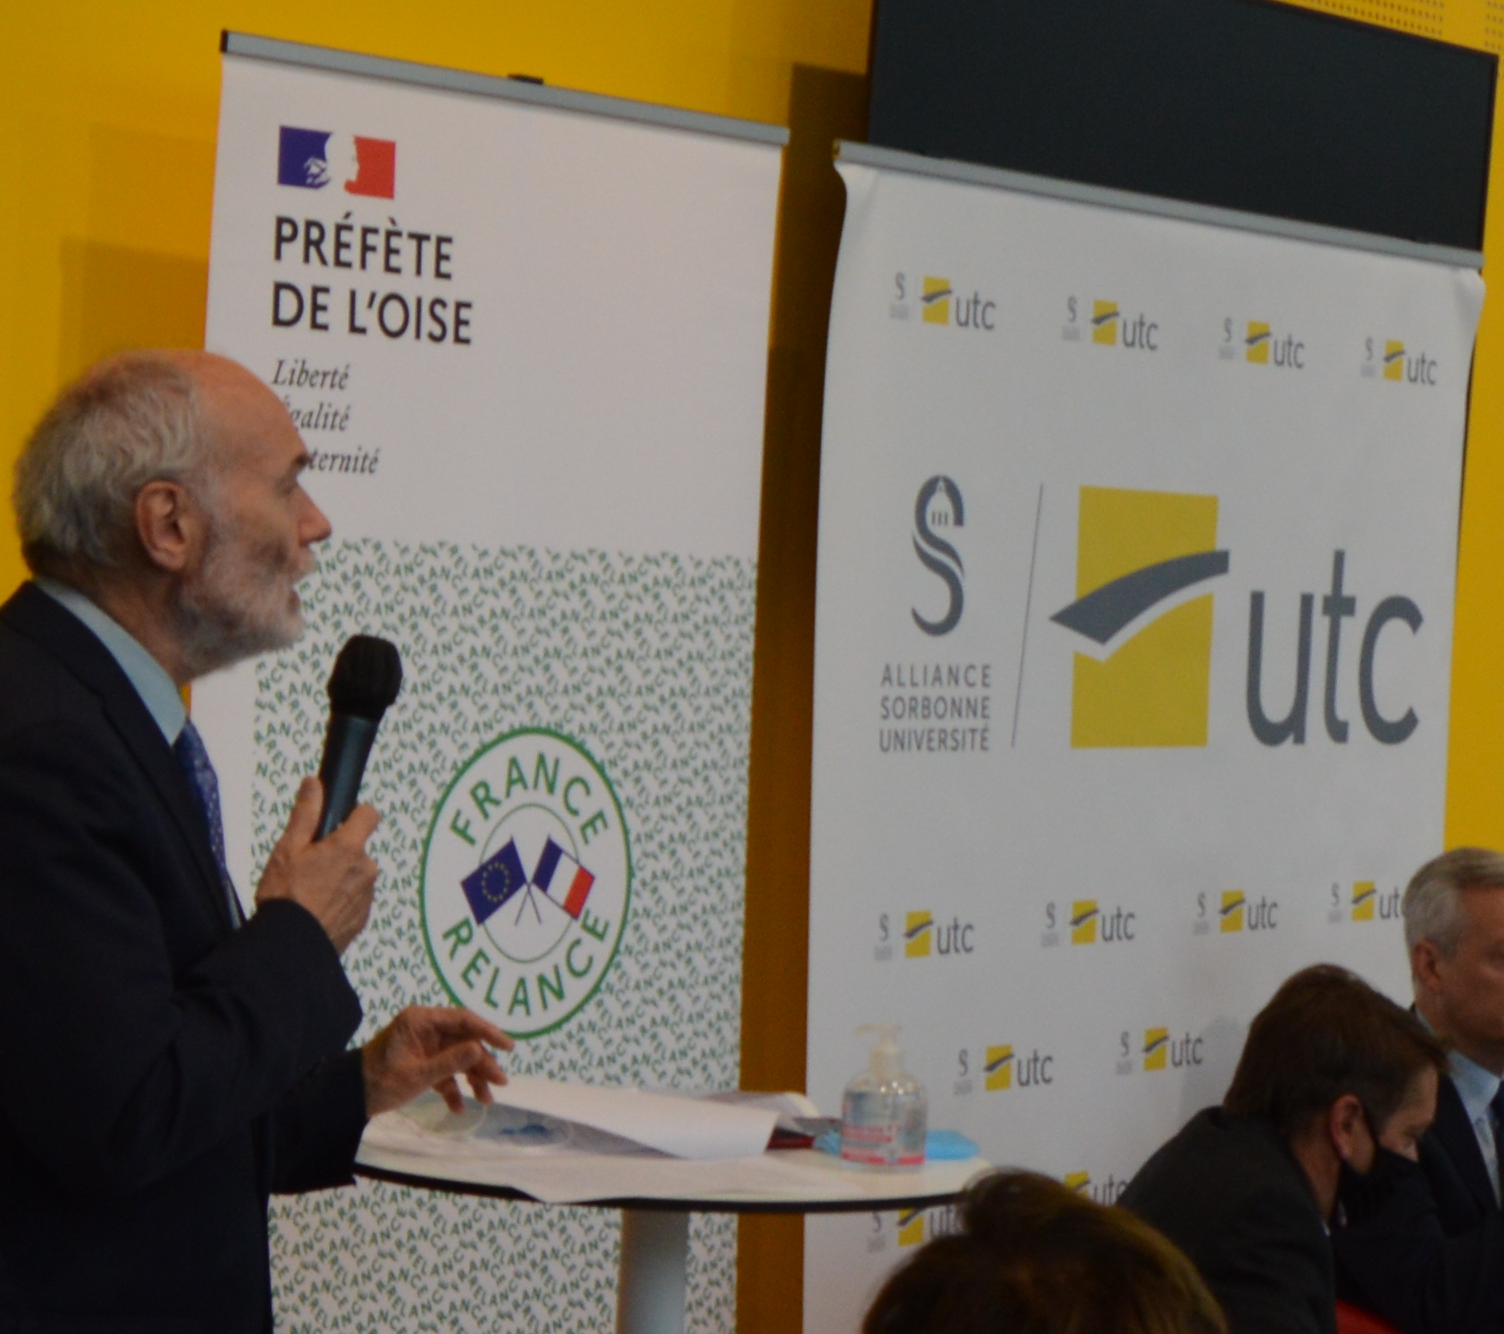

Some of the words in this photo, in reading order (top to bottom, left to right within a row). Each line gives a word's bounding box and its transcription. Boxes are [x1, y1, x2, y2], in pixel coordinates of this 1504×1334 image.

[273, 210, 454, 280] PRÉFÈTE
[272, 281, 330, 332] DE
[349, 289, 473, 345] L'OISE
[955, 291, 996, 331] utc
[1122, 313, 1159, 351] utc
[1273, 334, 1305, 369] utc
[1407, 352, 1437, 386] utc
[272, 359, 349, 391] Liberté
[1246, 549, 1424, 747] utc
[881, 664, 991, 688] ALLIANCE
[880, 695, 991, 720] SORBONNE
[878, 723, 990, 753] UNIVERSITÉ
[450, 752, 608, 846] FRANCE
[1247, 895, 1278, 930] utc
[1380, 886, 1403, 919] ut
[937, 916, 975, 955] utc
[1101, 906, 1136, 942] utc
[443, 909, 609, 1016] RELANCE
[1171, 1032, 1204, 1067] utc
[1017, 1049, 1053, 1087] utc
